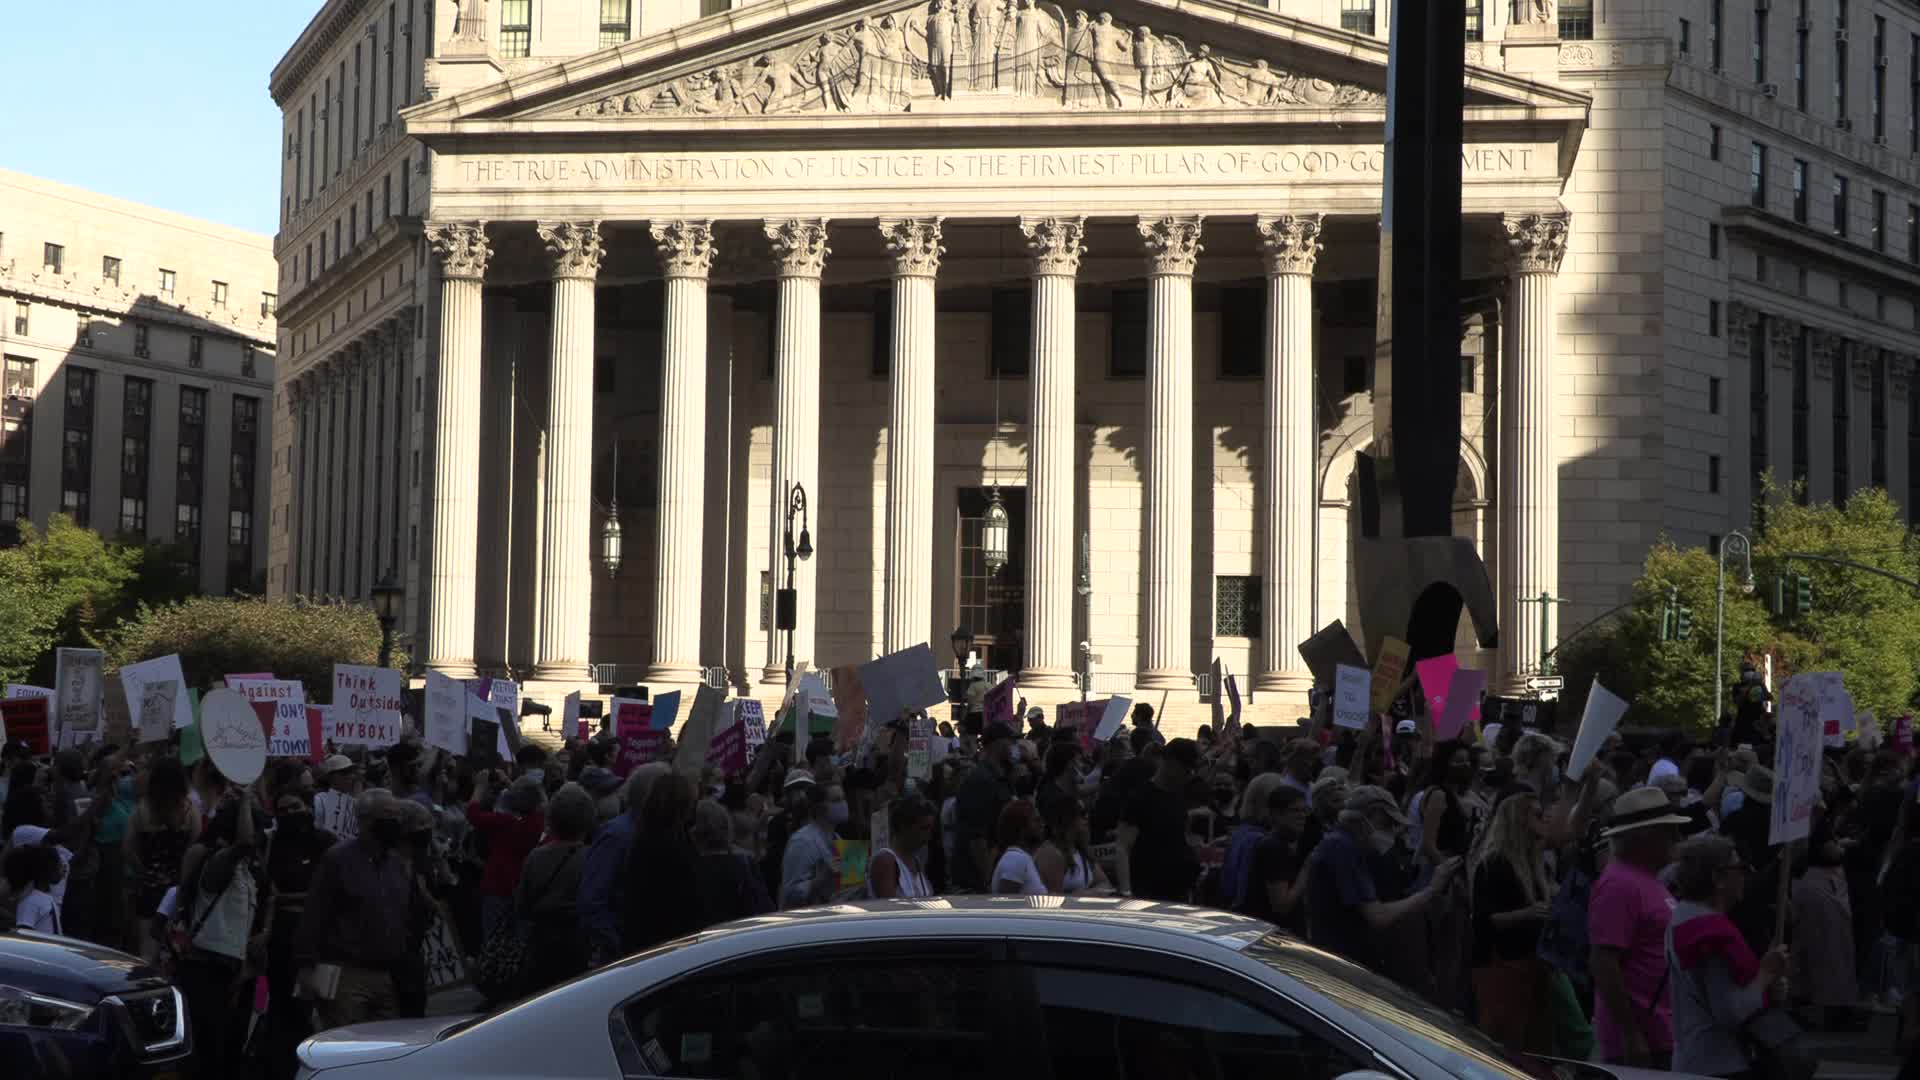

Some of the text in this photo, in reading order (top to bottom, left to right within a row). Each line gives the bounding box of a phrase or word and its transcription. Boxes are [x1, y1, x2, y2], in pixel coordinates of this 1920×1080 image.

[462, 159, 504, 181] THE
[512, 159, 569, 181] TRUE
[580, 157, 774, 181] ADMINISTRATION
[784, 156, 817, 178] OF
[830, 155, 924, 178] JUSTICE
[935, 154, 956, 177] IS
[963, 154, 1009, 177] THE
[1018, 153, 1121, 176] FIRMEST
[1130, 152, 1208, 175] PILLAR
[1217, 151, 1251, 174] OF
[1261, 151, 1339, 174] GOOD
[239, 681, 292, 698] Against
[336, 673, 376, 690] Think
[336, 722, 355, 737] MY
